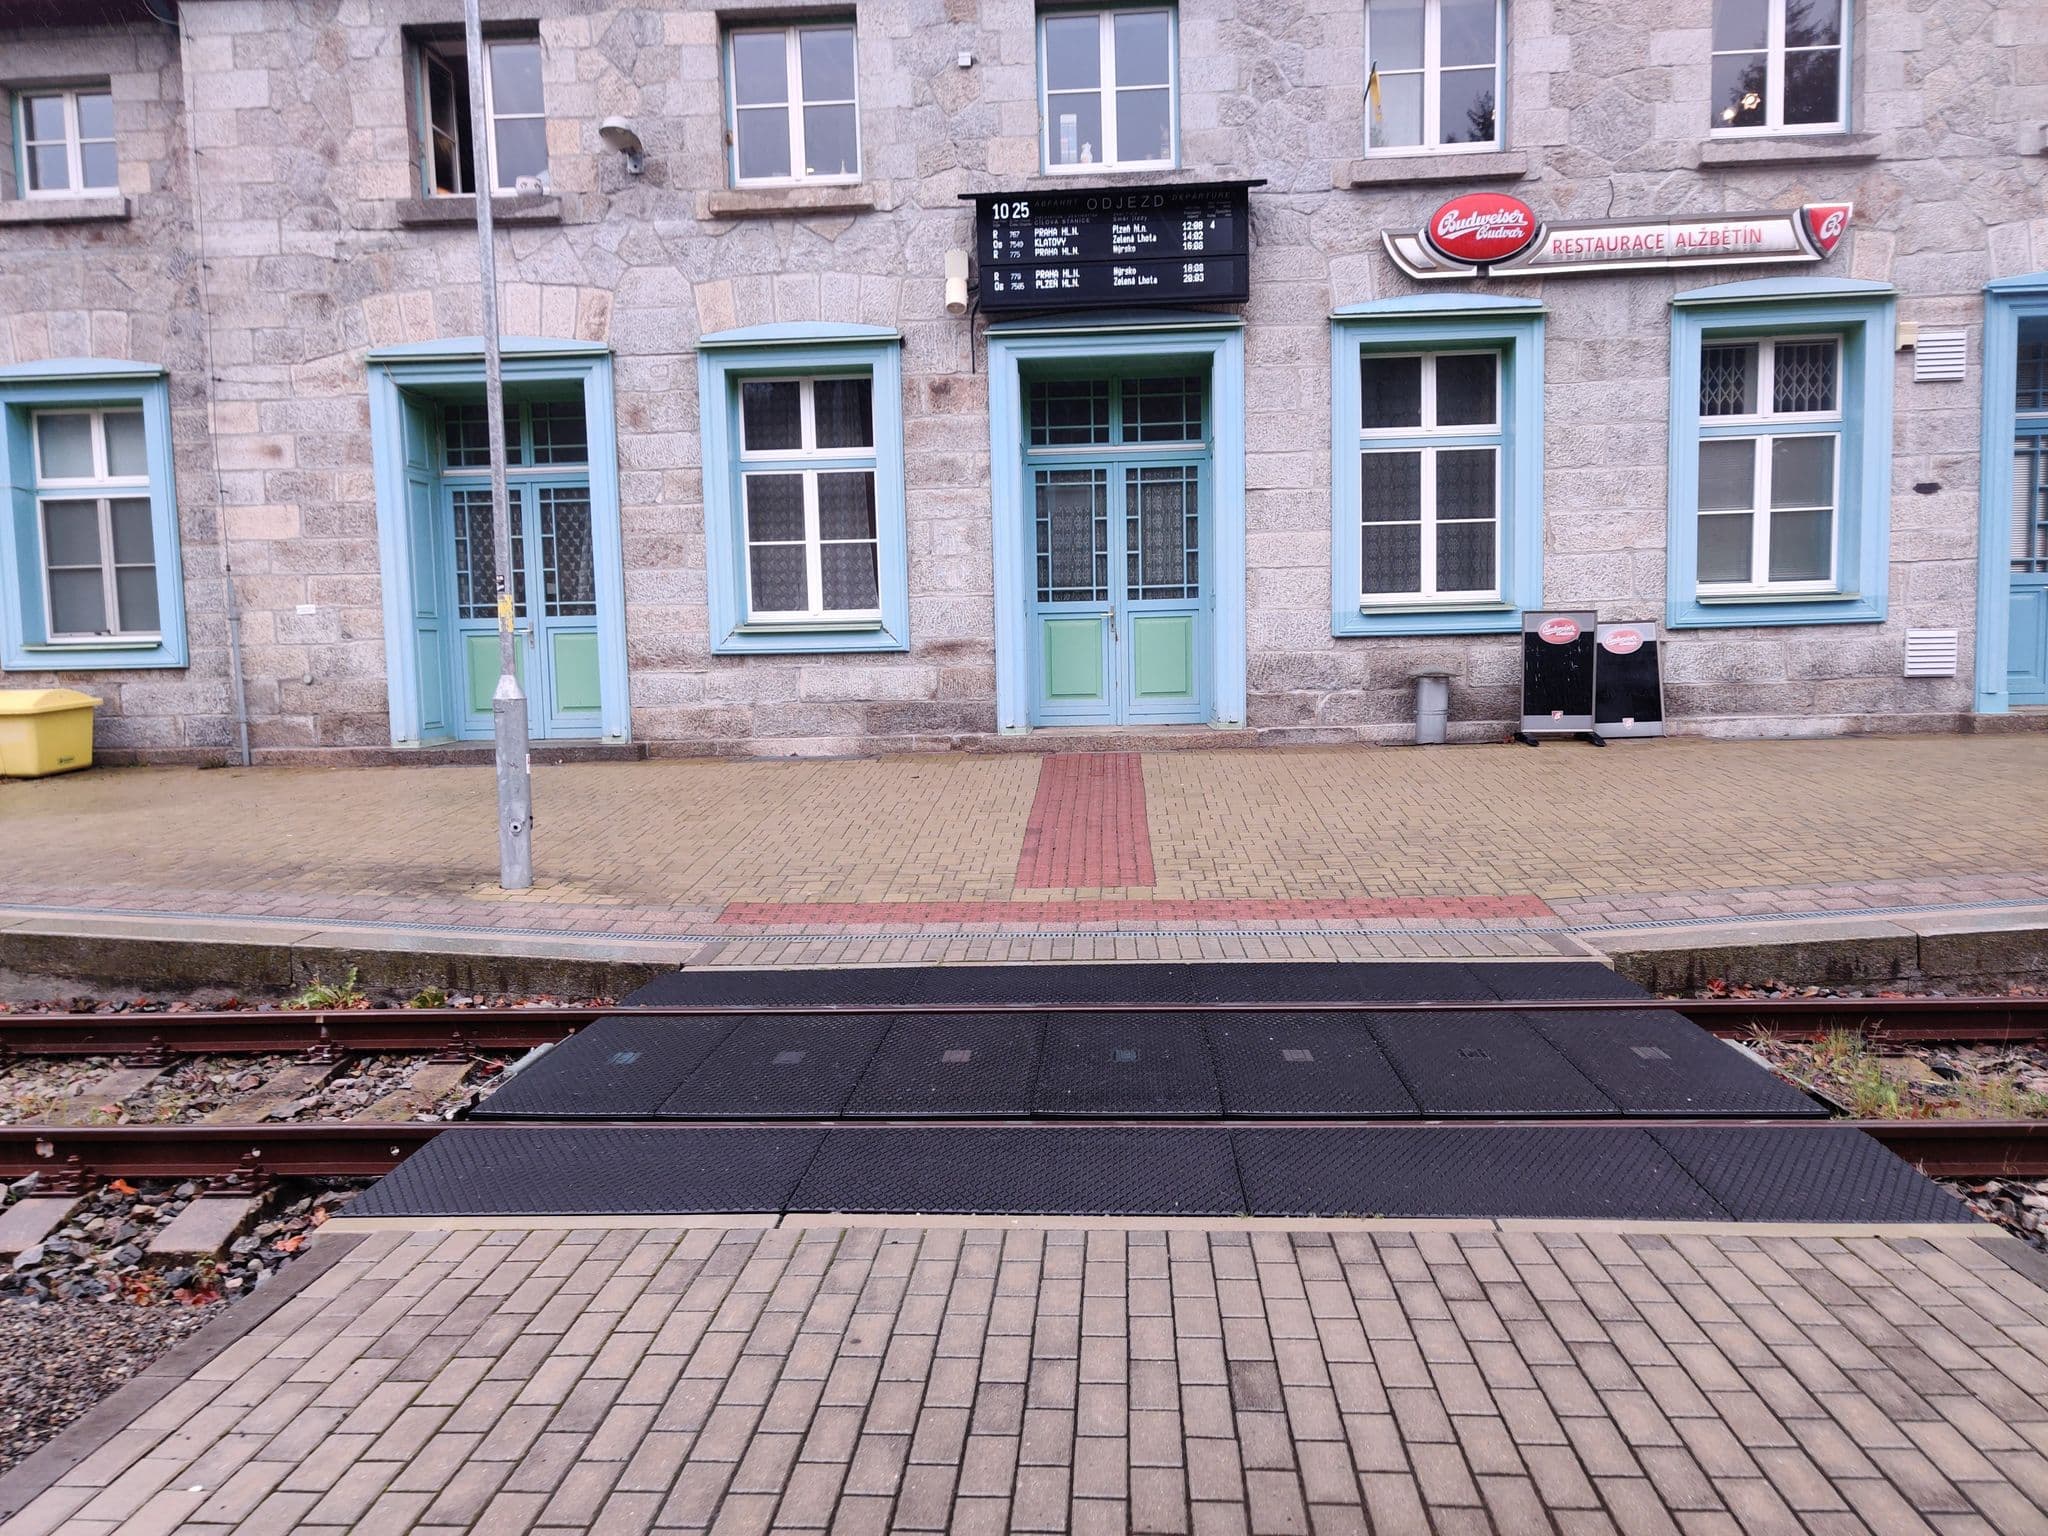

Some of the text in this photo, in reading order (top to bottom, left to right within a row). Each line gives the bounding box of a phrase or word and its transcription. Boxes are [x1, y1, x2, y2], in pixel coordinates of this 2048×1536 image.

[1086, 194, 1165, 210] ODJEZD
[992, 201, 1030, 220] 10 25
[992, 229, 998, 239] R
[1034, 227, 1058, 237] PRAHA
[1209, 219, 1216, 229] 4
[1438, 208, 1528, 240] Budweiser
[1034, 237, 1067, 248] KLATOVY
[1112, 234, 1135, 244] Zelená
[1137, 233, 1157, 243] Lhota
[1182, 231, 1204, 241] 14:02
[1476, 226, 1526, 241] Budvar
[1552, 224, 1762, 255] RESTAURACE ALŽBĚTÍN
[993, 249, 999, 259] R
[1035, 247, 1059, 257] PRAHA
[994, 271, 999, 281] R
[1035, 269, 1059, 279] PRAHA
[1113, 277, 1136, 286] Zelená
[1138, 275, 1158, 285] Lhota
